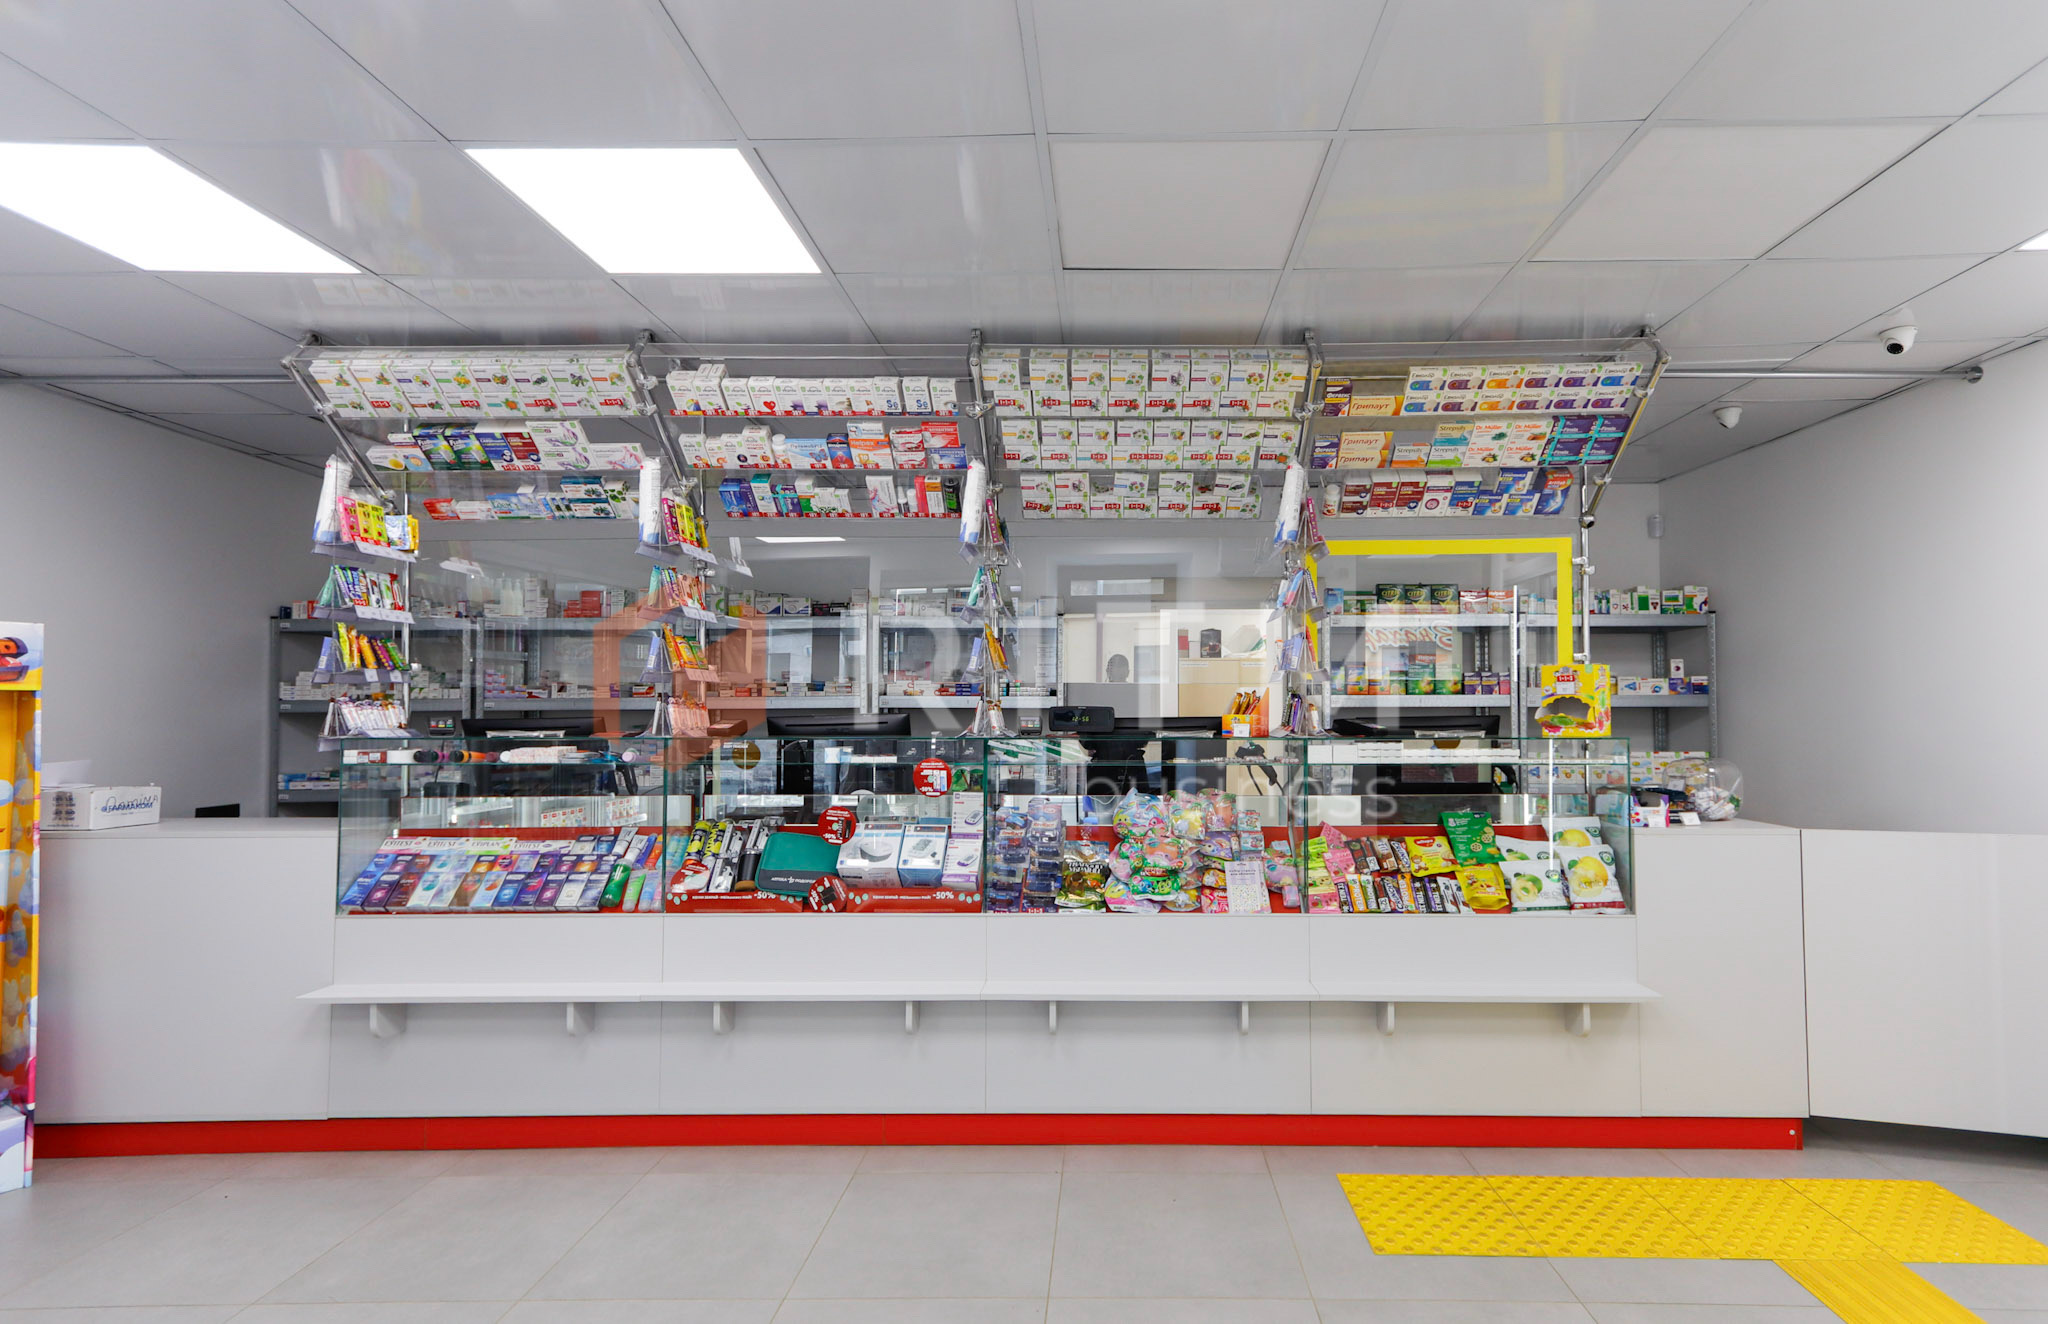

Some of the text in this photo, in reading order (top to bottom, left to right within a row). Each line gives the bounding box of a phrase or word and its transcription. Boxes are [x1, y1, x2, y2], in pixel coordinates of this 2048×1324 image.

[886, 399, 899, 408] Se
[916, 399, 928, 408] Se
[1352, 402, 1390, 410] Грипаут
[753, 890, 776, 899] -50%
[932, 891, 955, 900] -50%
